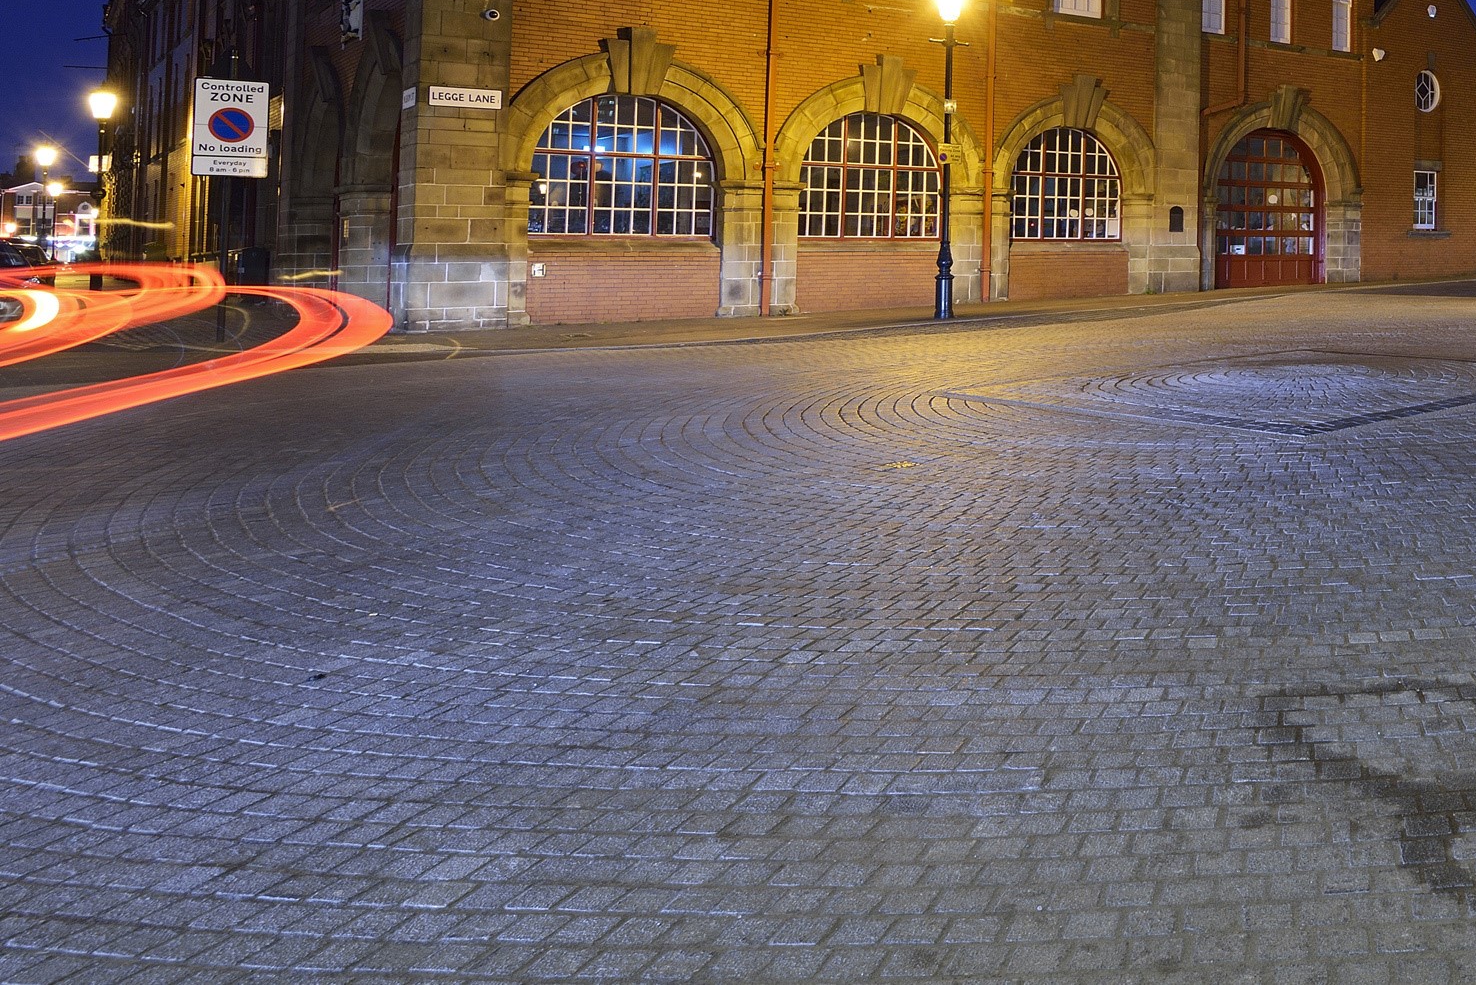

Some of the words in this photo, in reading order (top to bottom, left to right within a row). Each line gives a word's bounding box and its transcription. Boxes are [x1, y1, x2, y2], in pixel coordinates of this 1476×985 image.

[201, 82, 264, 93] Controlled
[210, 92, 254, 103] ZONE
[432, 92, 464, 102] LEGGE
[468, 94, 496, 103] LANE
[198, 143, 215, 152] No
[219, 144, 262, 154] loading
[213, 159, 247, 167] Everyday
